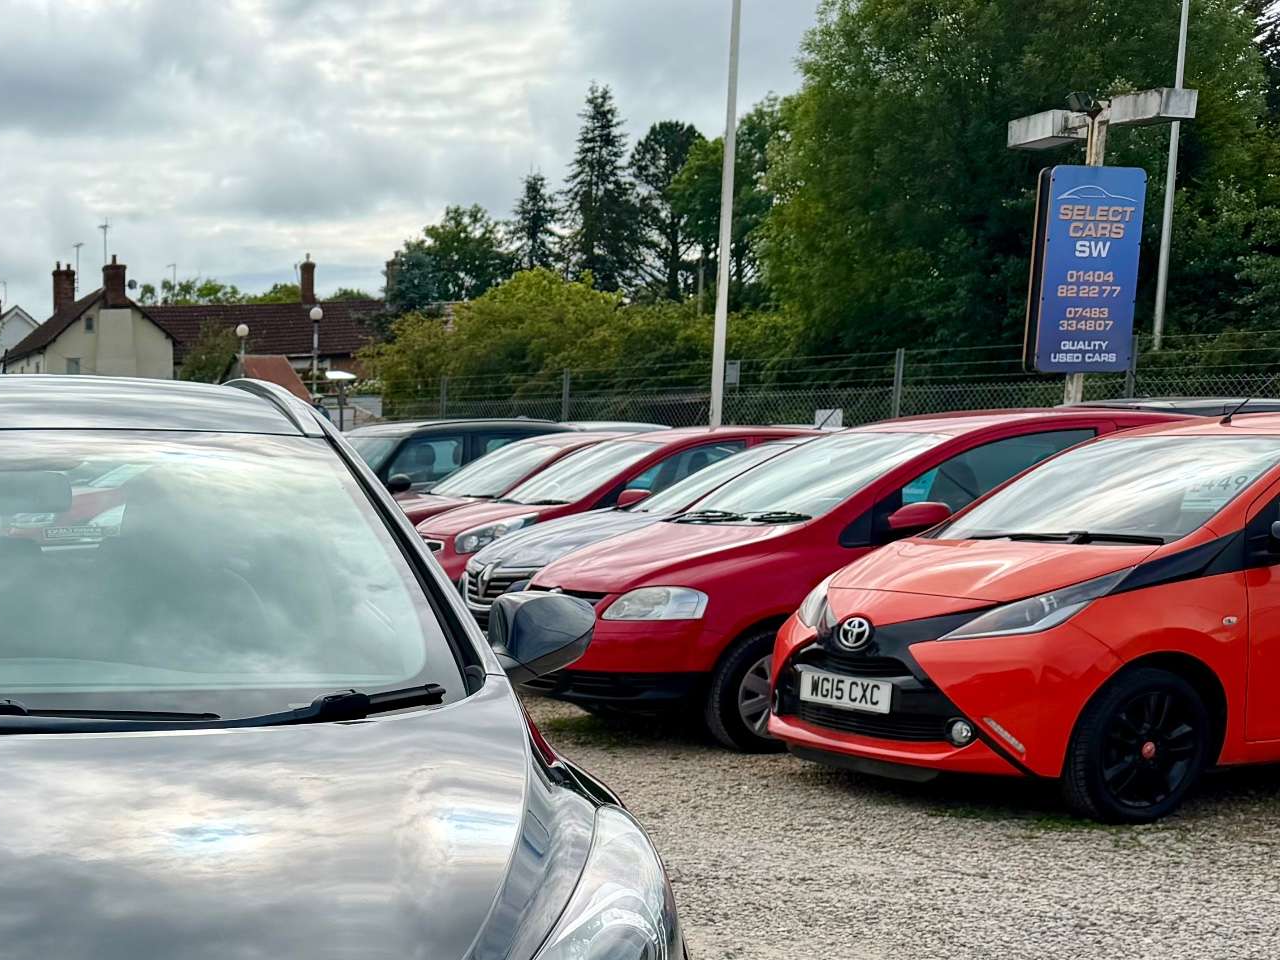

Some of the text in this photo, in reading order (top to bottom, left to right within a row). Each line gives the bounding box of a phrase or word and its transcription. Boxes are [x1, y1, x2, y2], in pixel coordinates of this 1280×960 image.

[1058, 204, 1135, 222] SELECT
[1069, 222, 1125, 239] CARS
[1075, 240, 1110, 258] SW
[1066, 271, 1114, 283] 01404
[1065, 308, 1109, 318] 07483
[1059, 320, 1114, 331] 334807
[1060, 340, 1109, 351] QUALITY
[1051, 353, 1116, 363] USED CARS
[810, 675, 881, 706] WG15 CXC
